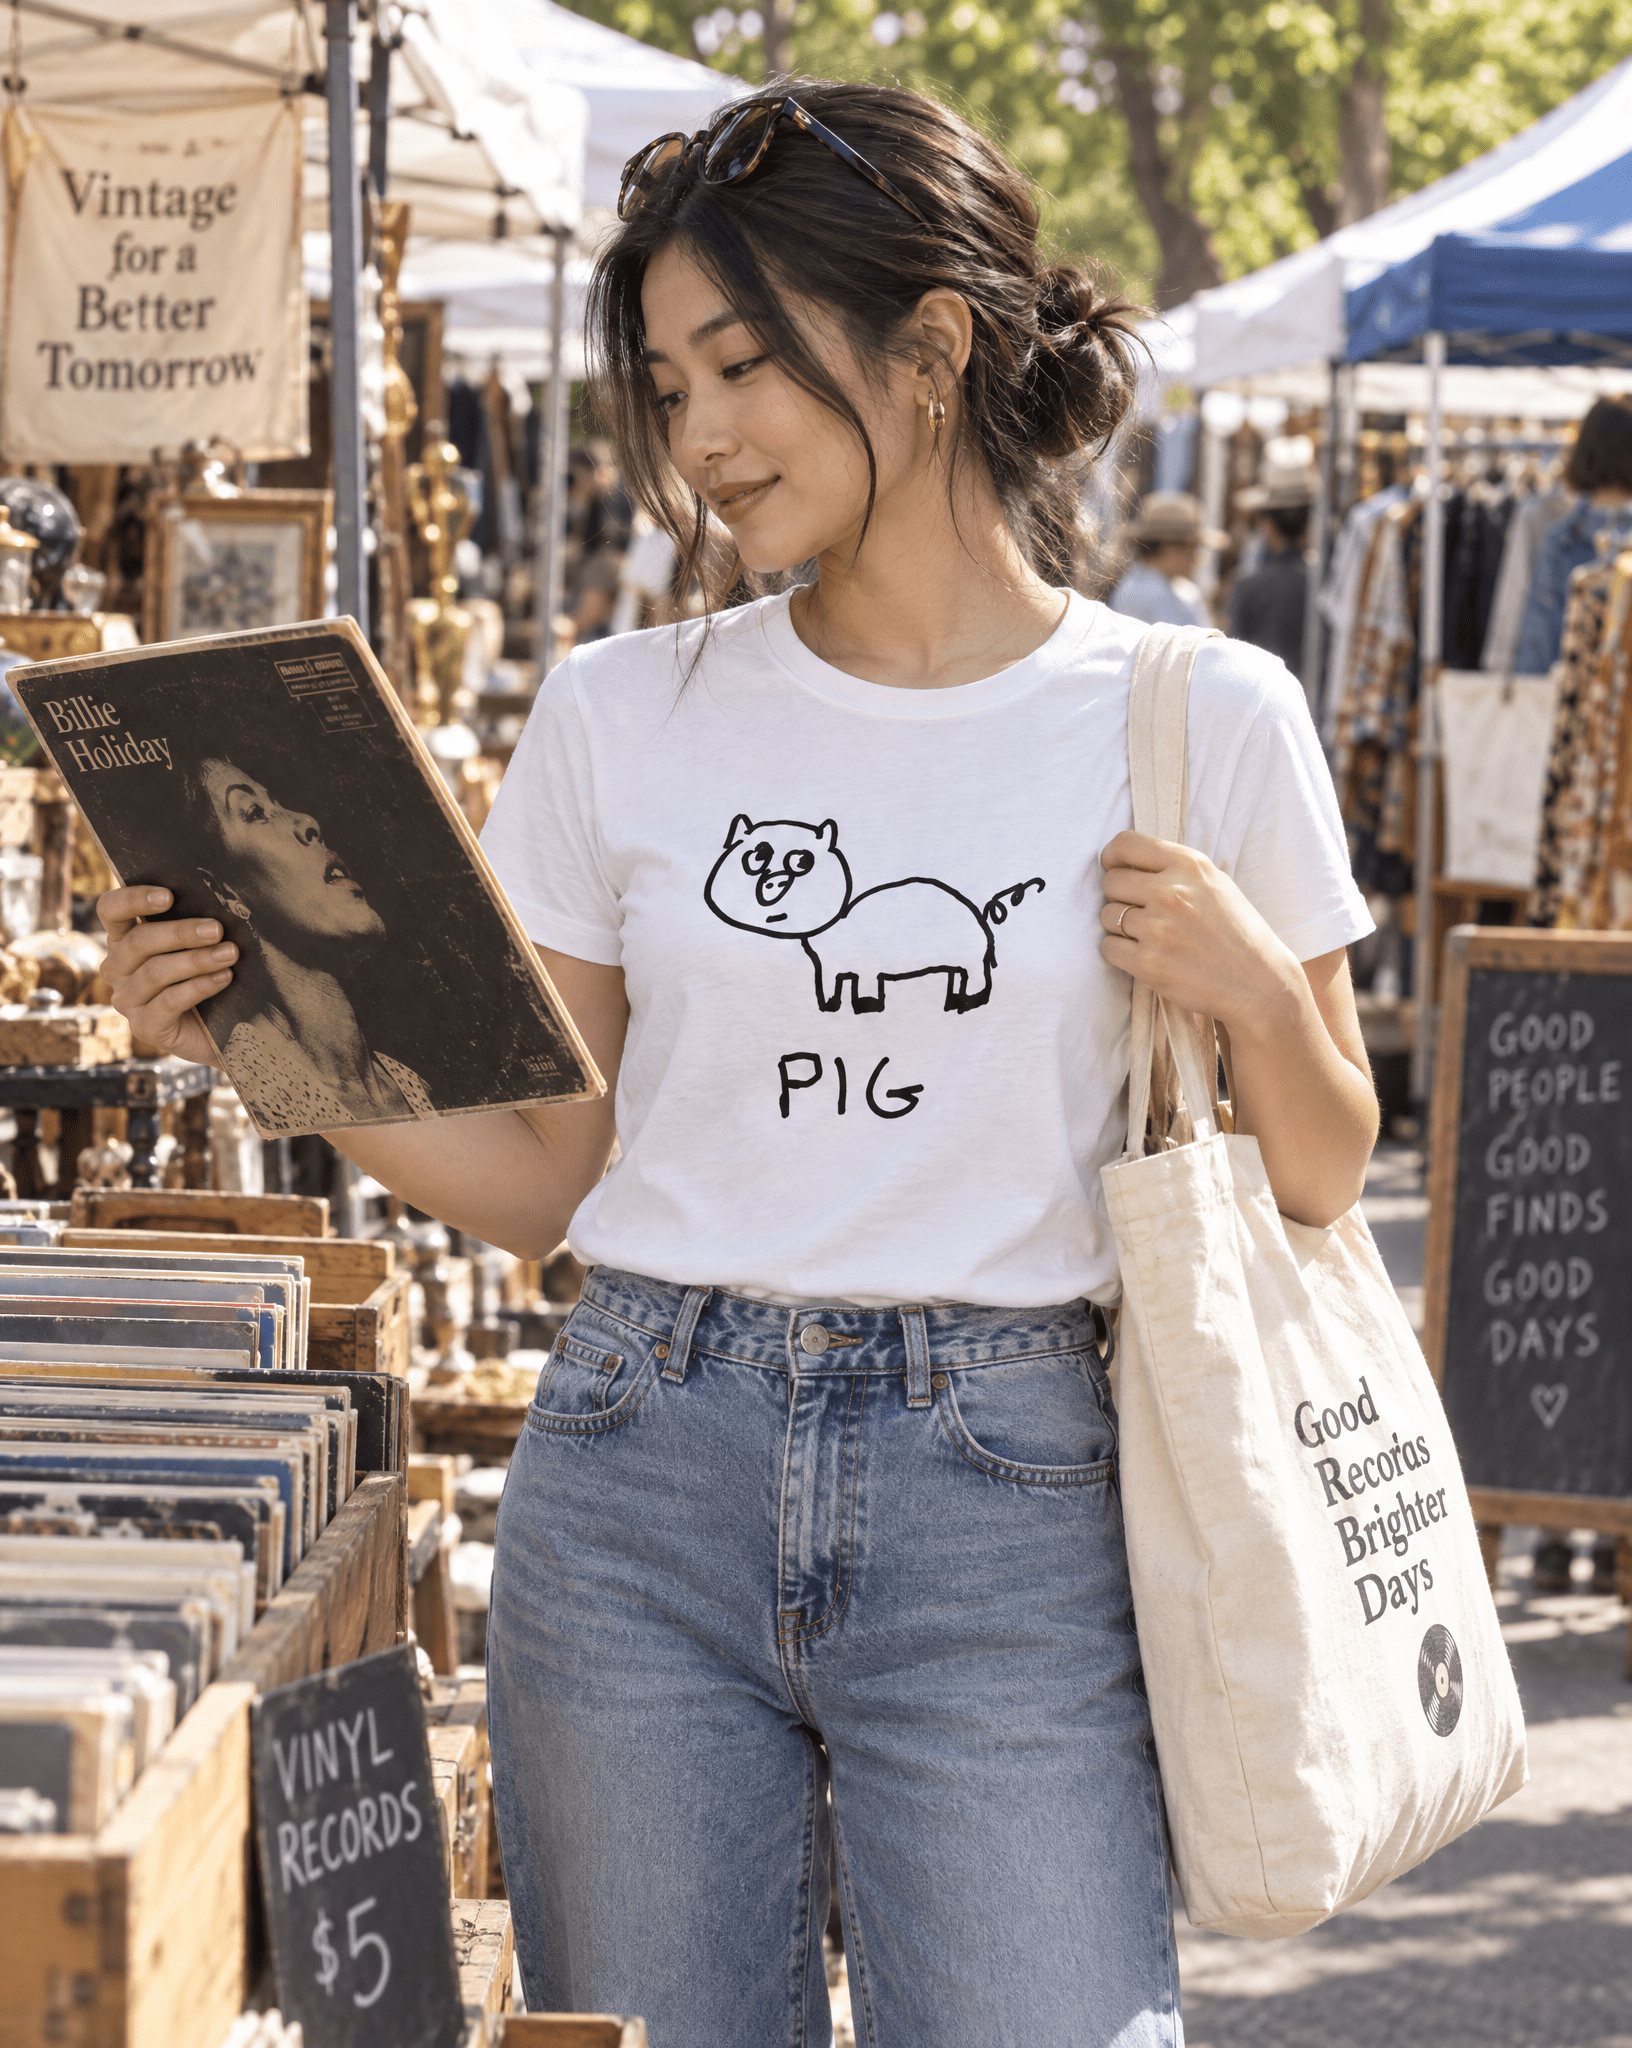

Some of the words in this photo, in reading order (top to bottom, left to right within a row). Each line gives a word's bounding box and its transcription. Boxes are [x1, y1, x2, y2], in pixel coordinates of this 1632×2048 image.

[61, 166, 238, 232] Vintage
[106, 230, 168, 282] for
[175, 242, 197, 274] a
[76, 284, 216, 332] Better
[37, 340, 264, 391] Tomorrow
[43, 695, 120, 733] Billie
[64, 731, 173, 772] Holiday
[1488, 1010, 1595, 1058] GOOD
[778, 1052, 924, 1119] PIG
[1487, 1060, 1622, 1114] PEOPLE
[1484, 1132, 1592, 1180] GOOD
[1486, 1187, 1609, 1240] FINDS
[1483, 1256, 1593, 1307] GOOD
[1490, 1311, 1600, 1366] DAYS
[1294, 1375, 1380, 1449] Good
[1334, 1487, 1449, 1568] Brighter
[1354, 1558, 1434, 1626] Days
[272, 1707, 394, 1801] VINYL
[277, 1781, 422, 1893] RECORDS
[312, 1897, 391, 2008] $5
